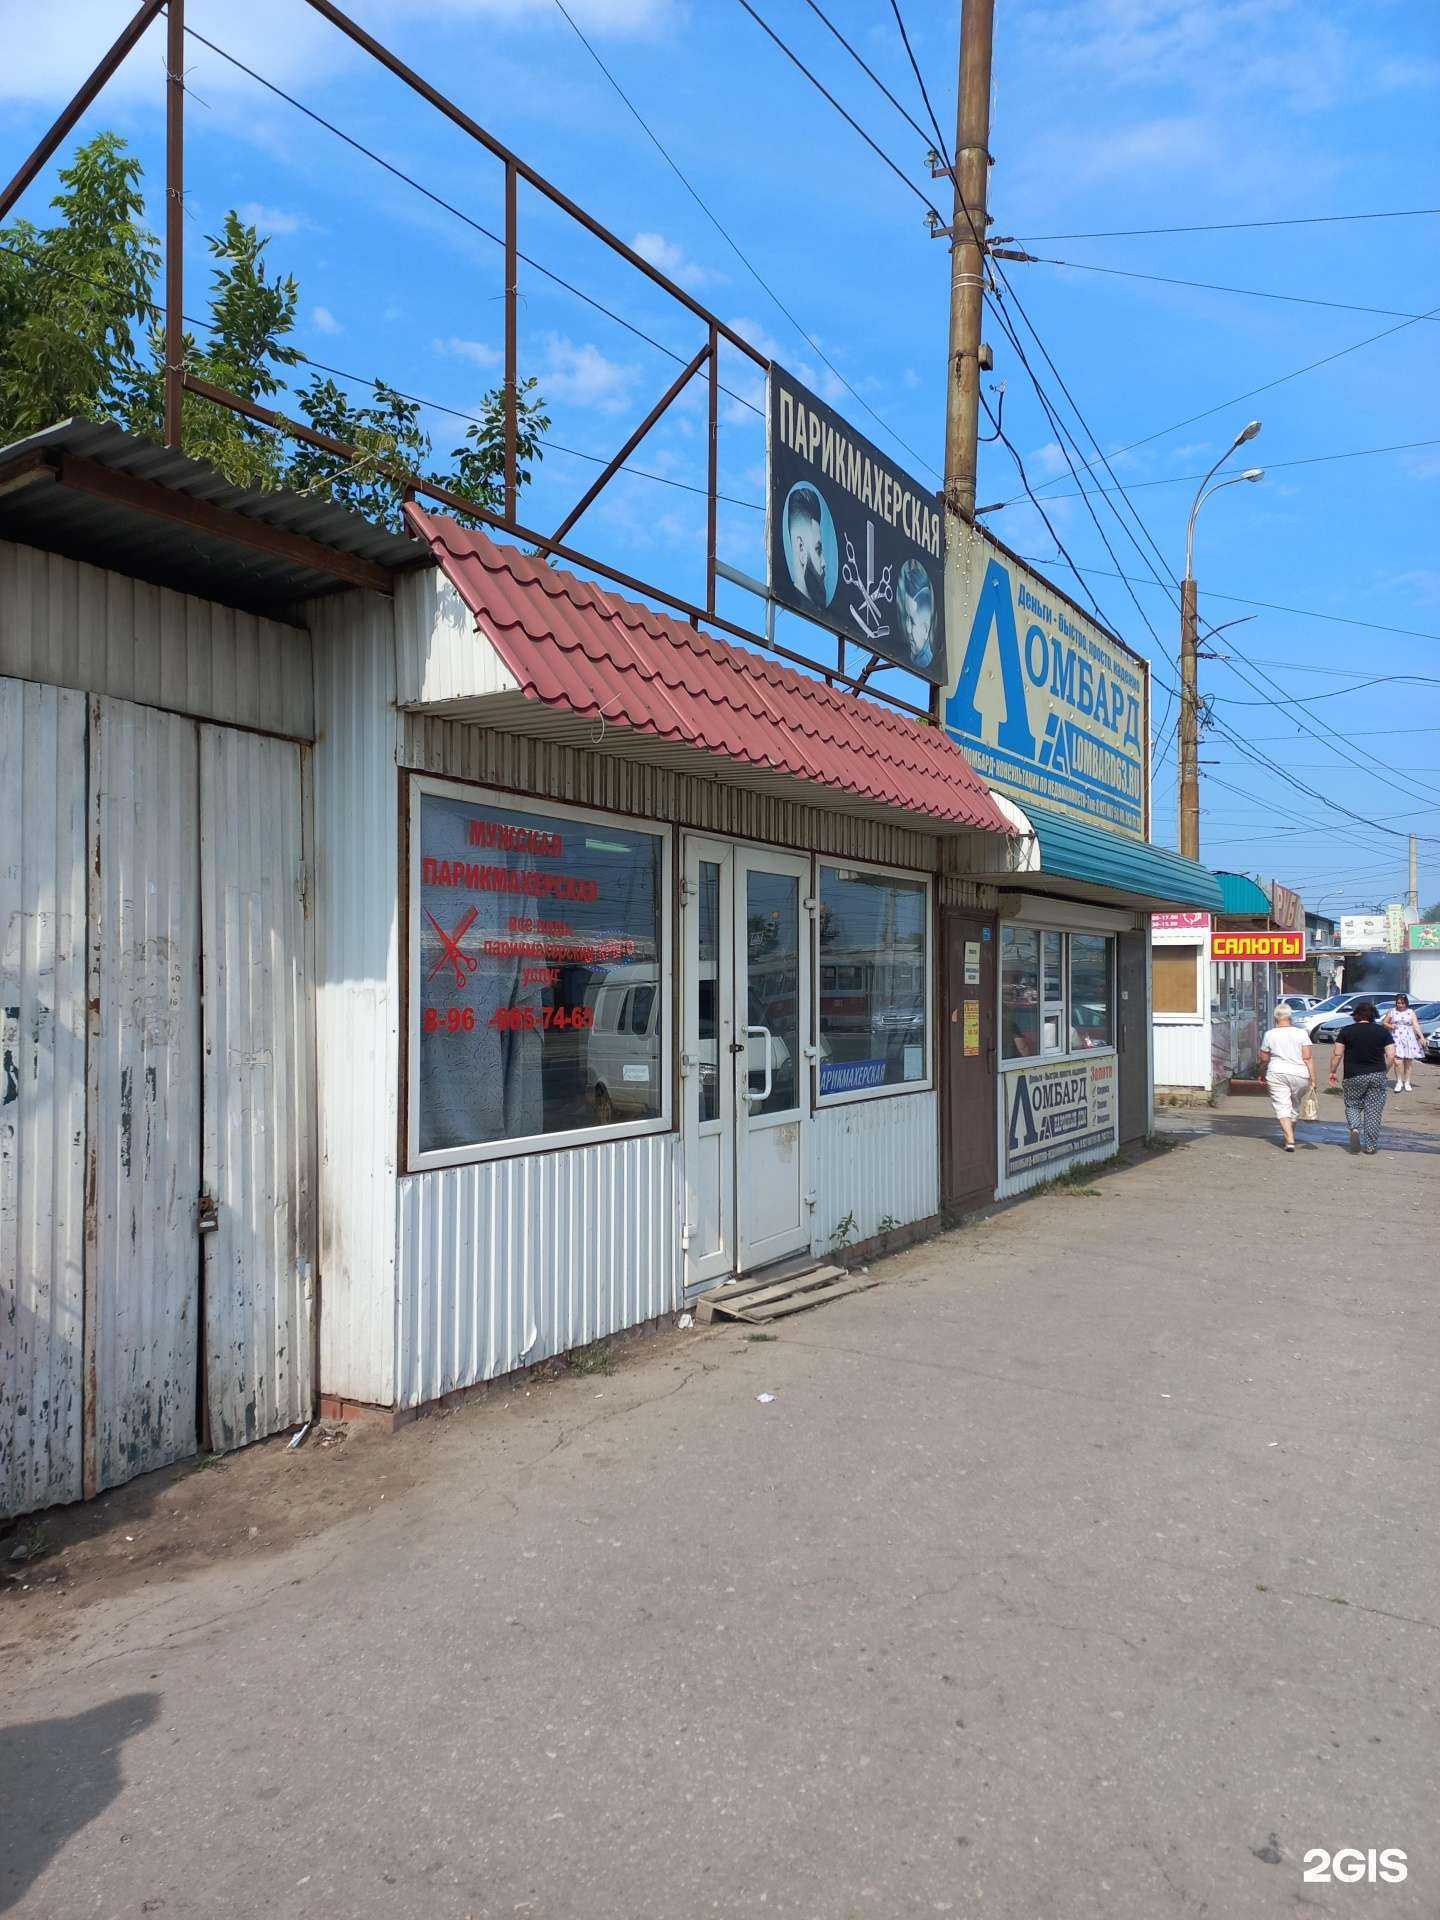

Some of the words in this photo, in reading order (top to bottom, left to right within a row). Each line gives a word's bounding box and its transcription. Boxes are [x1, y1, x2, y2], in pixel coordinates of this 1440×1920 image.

[779, 386, 941, 559] ПАРИКМАХЕРСКАЯ
[945, 557, 1141, 761] ЛОМБАРД
[1072, 732, 1140, 799] LOMBARD63.RU
[1212, 937, 1301, 956] САЛЮТЫ
[820, 1063, 887, 1091] АРИКМАХЕРСКАЯ
[1008, 1074, 1089, 1151] ЛОМБАРД
